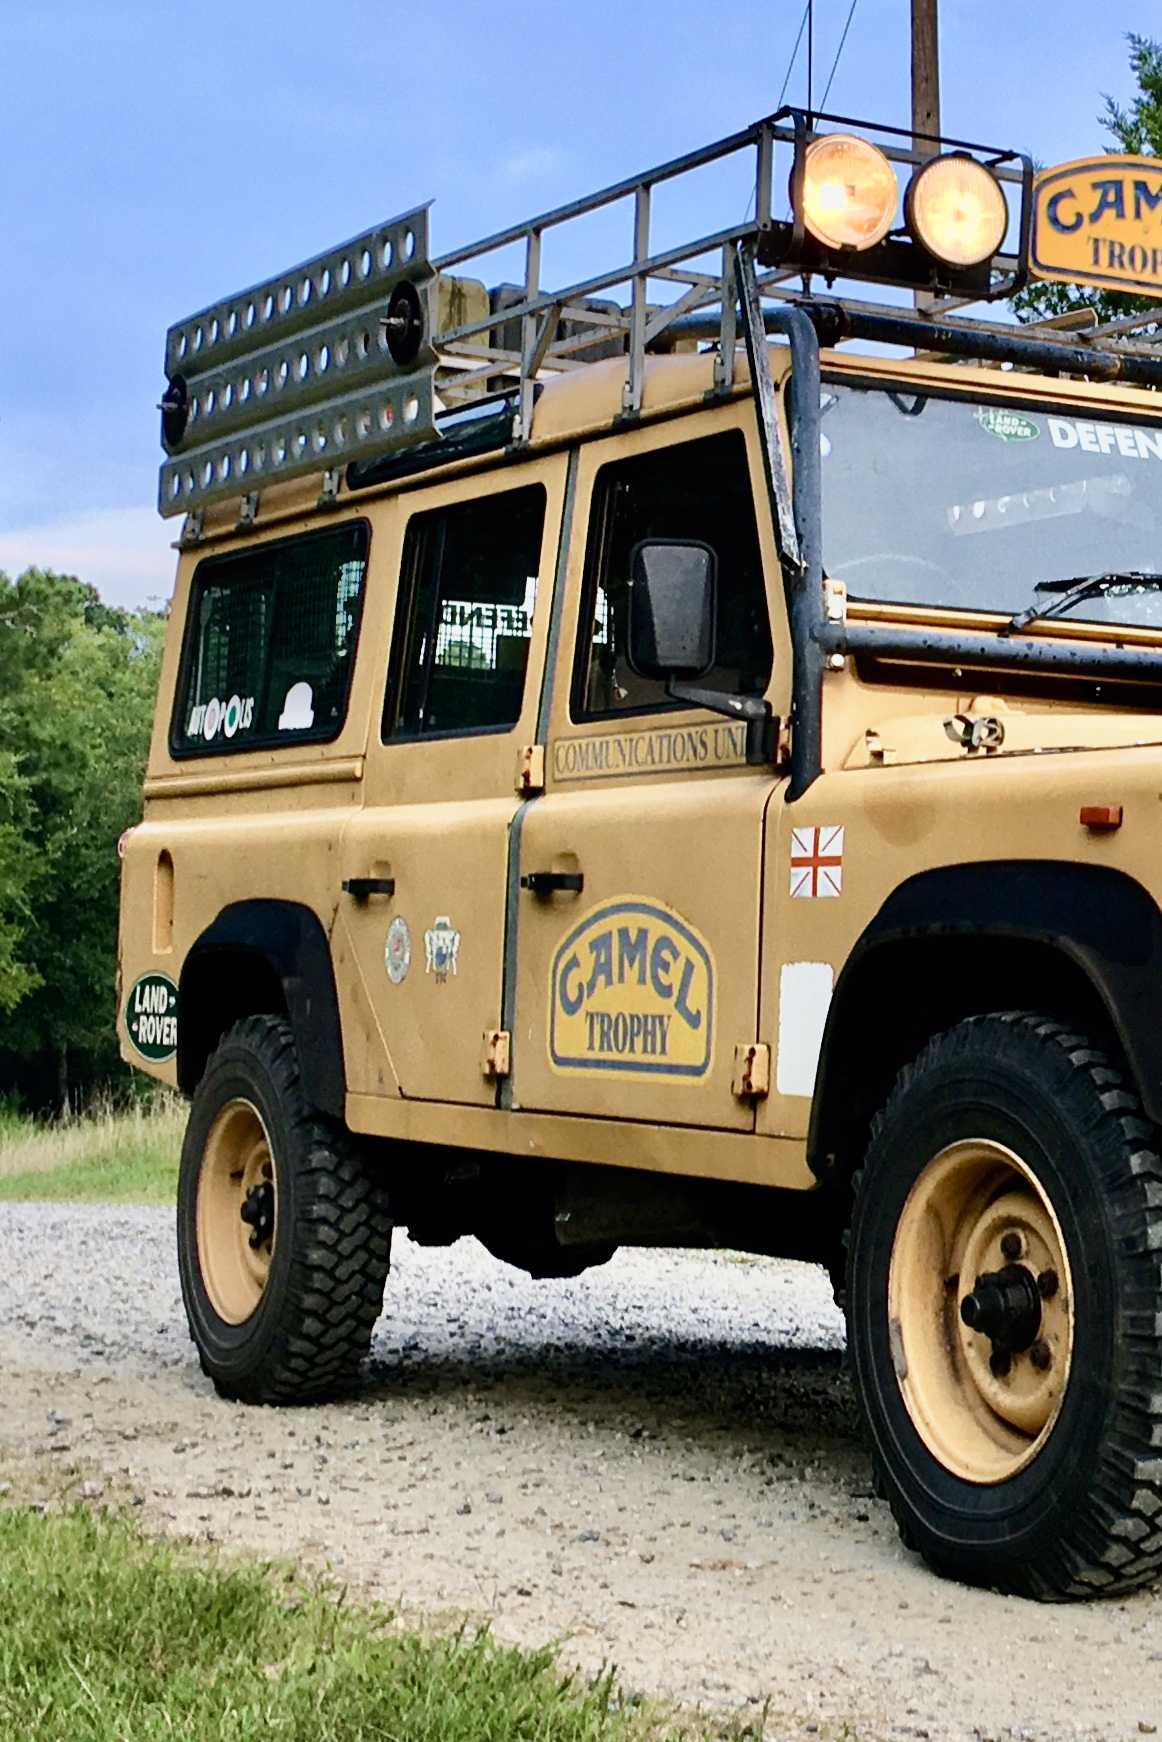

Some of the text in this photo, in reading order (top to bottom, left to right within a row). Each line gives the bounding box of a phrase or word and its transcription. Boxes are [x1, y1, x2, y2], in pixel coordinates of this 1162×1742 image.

[555, 724, 747, 773] COMMUNICATIONS UNI
[134, 985, 168, 1013] LAND
[559, 927, 701, 1030] CAMEL
[585, 1012, 672, 1056] TROPHY
